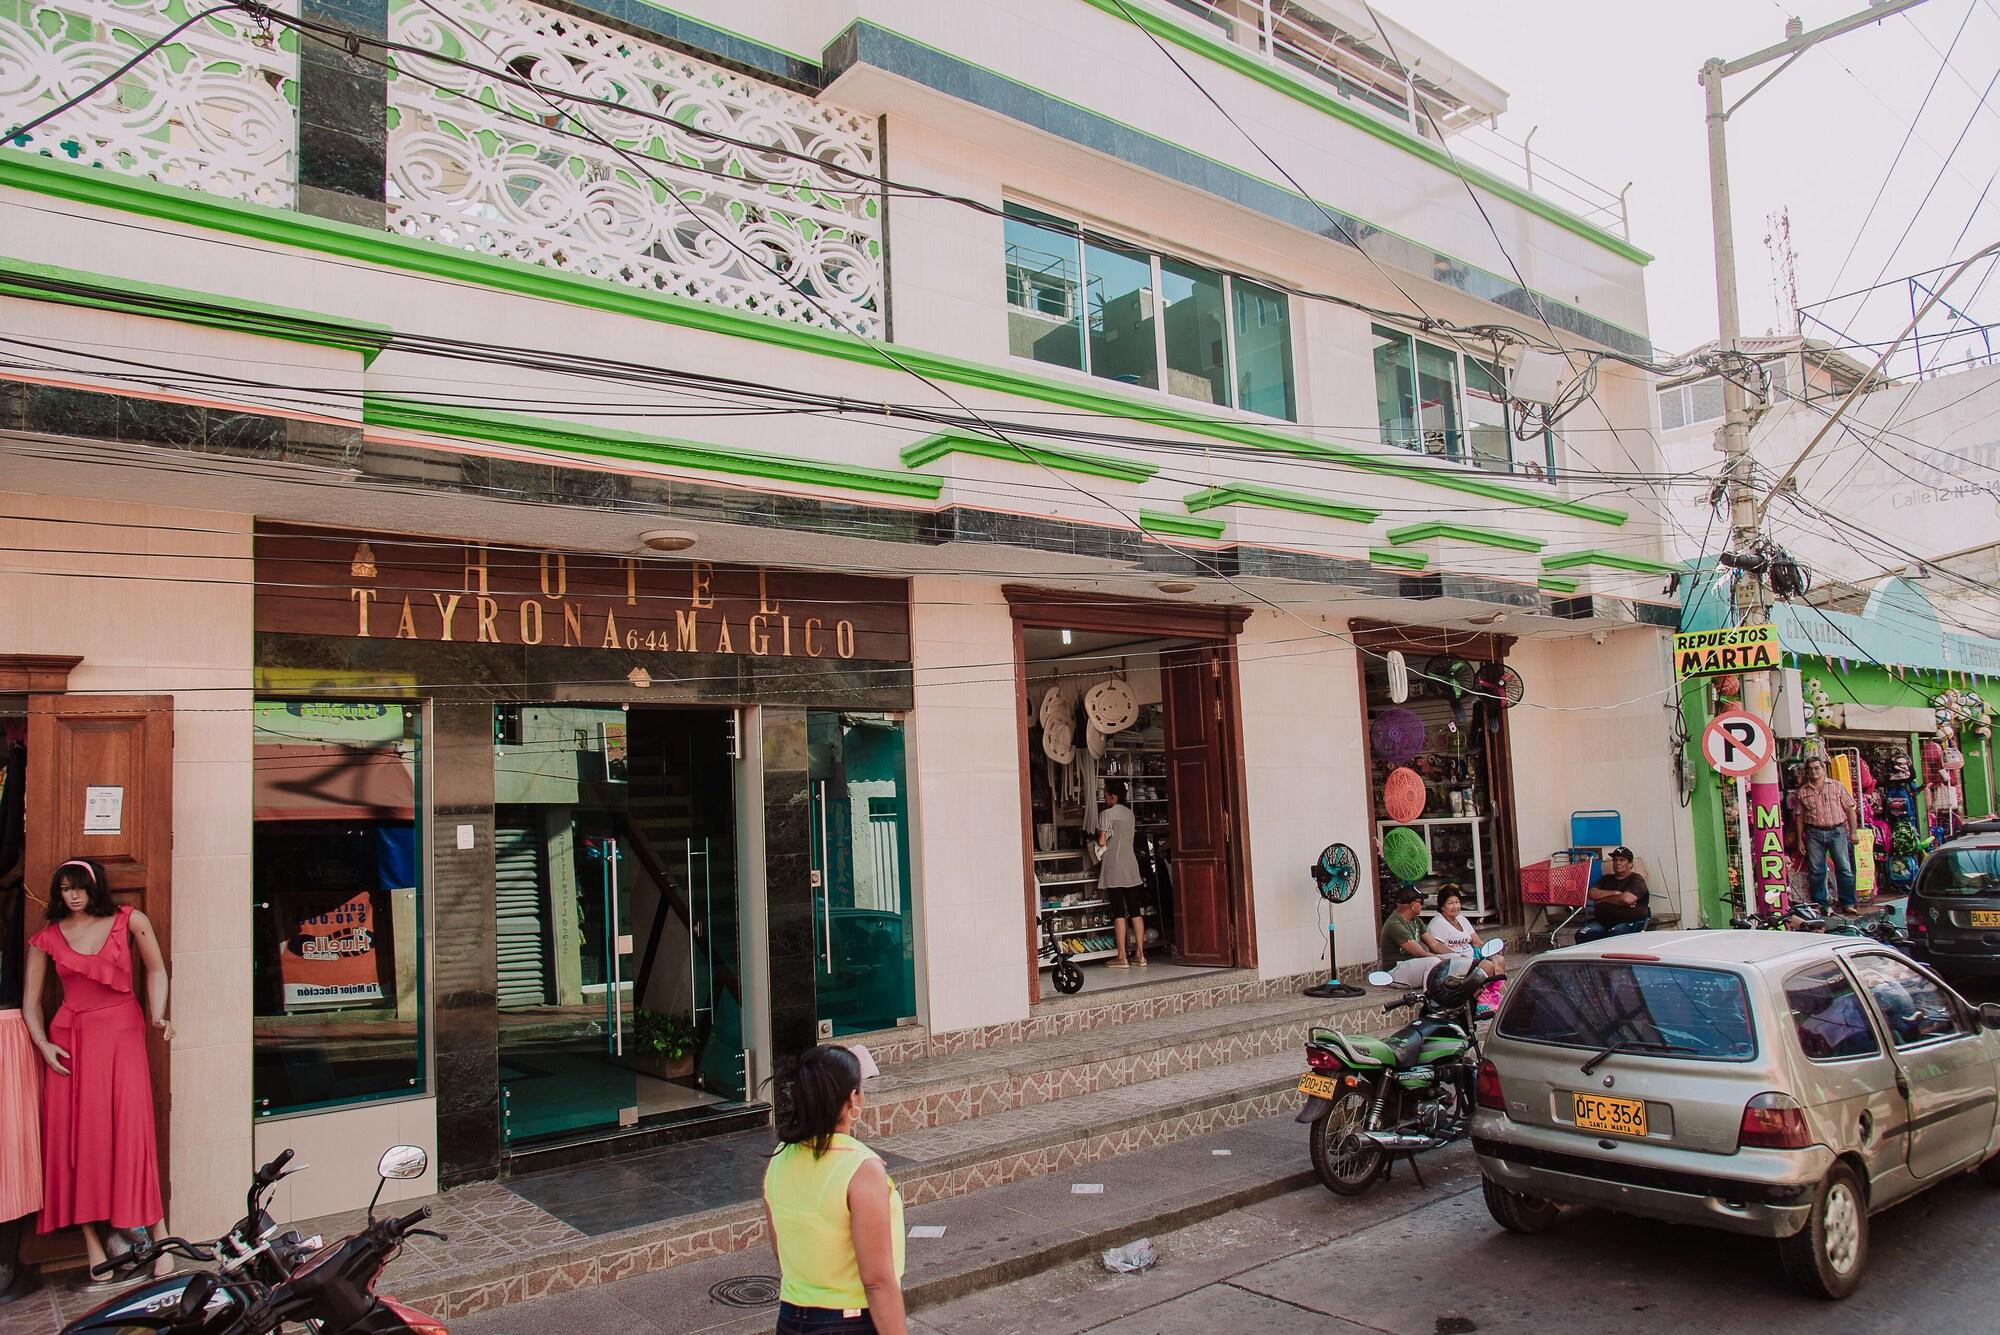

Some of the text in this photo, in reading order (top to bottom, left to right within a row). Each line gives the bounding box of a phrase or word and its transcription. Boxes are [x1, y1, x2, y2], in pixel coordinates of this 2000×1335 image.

[1892, 488, 1932, 510] Calle
[1935, 488, 1950, 503] 12
[463, 540, 780, 615] HOTEL
[351, 588, 855, 659] TAYRONA MAGICO
[626, 629, 669, 651] 6-44
[1677, 627, 1769, 650] REPUESTOS
[1681, 645, 1771, 674] MARTA
[1723, 722, 1756, 763] P
[1972, 912, 1990, 923] BLV
[1589, 1121, 1631, 1132] SANTA MARTA
